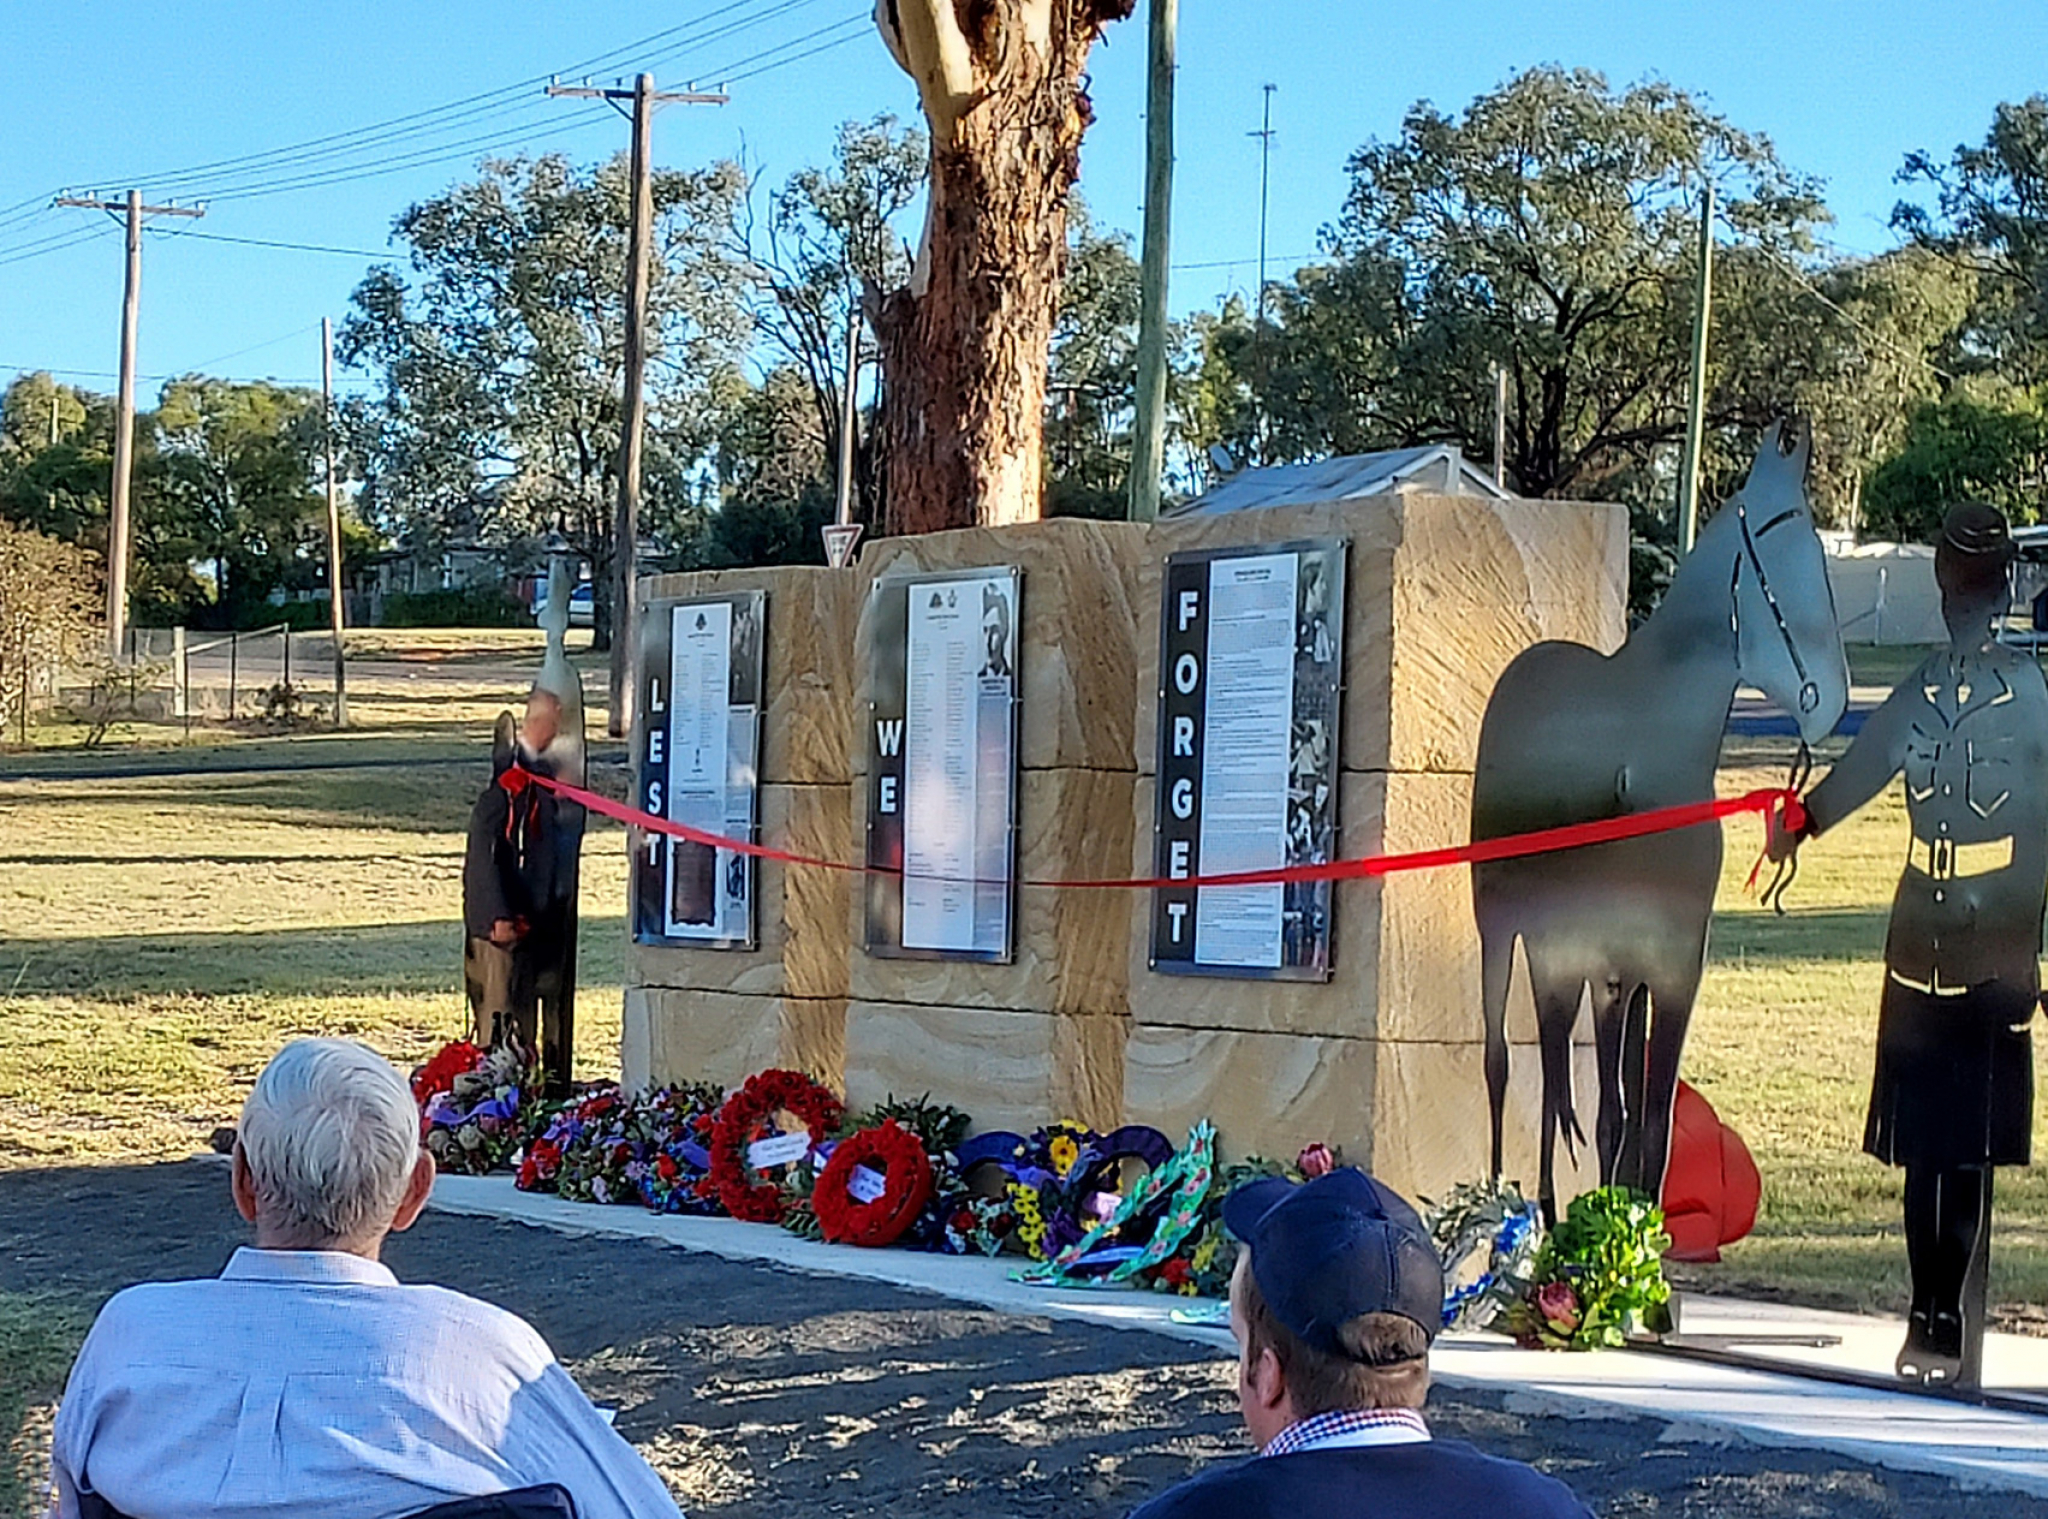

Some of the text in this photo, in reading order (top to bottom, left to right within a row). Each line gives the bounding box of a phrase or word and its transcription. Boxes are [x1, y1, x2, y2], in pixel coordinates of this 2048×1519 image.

[646, 679, 664, 866] LEST
[876, 719, 903, 813] WE
[1167, 591, 1199, 943] FORGET
